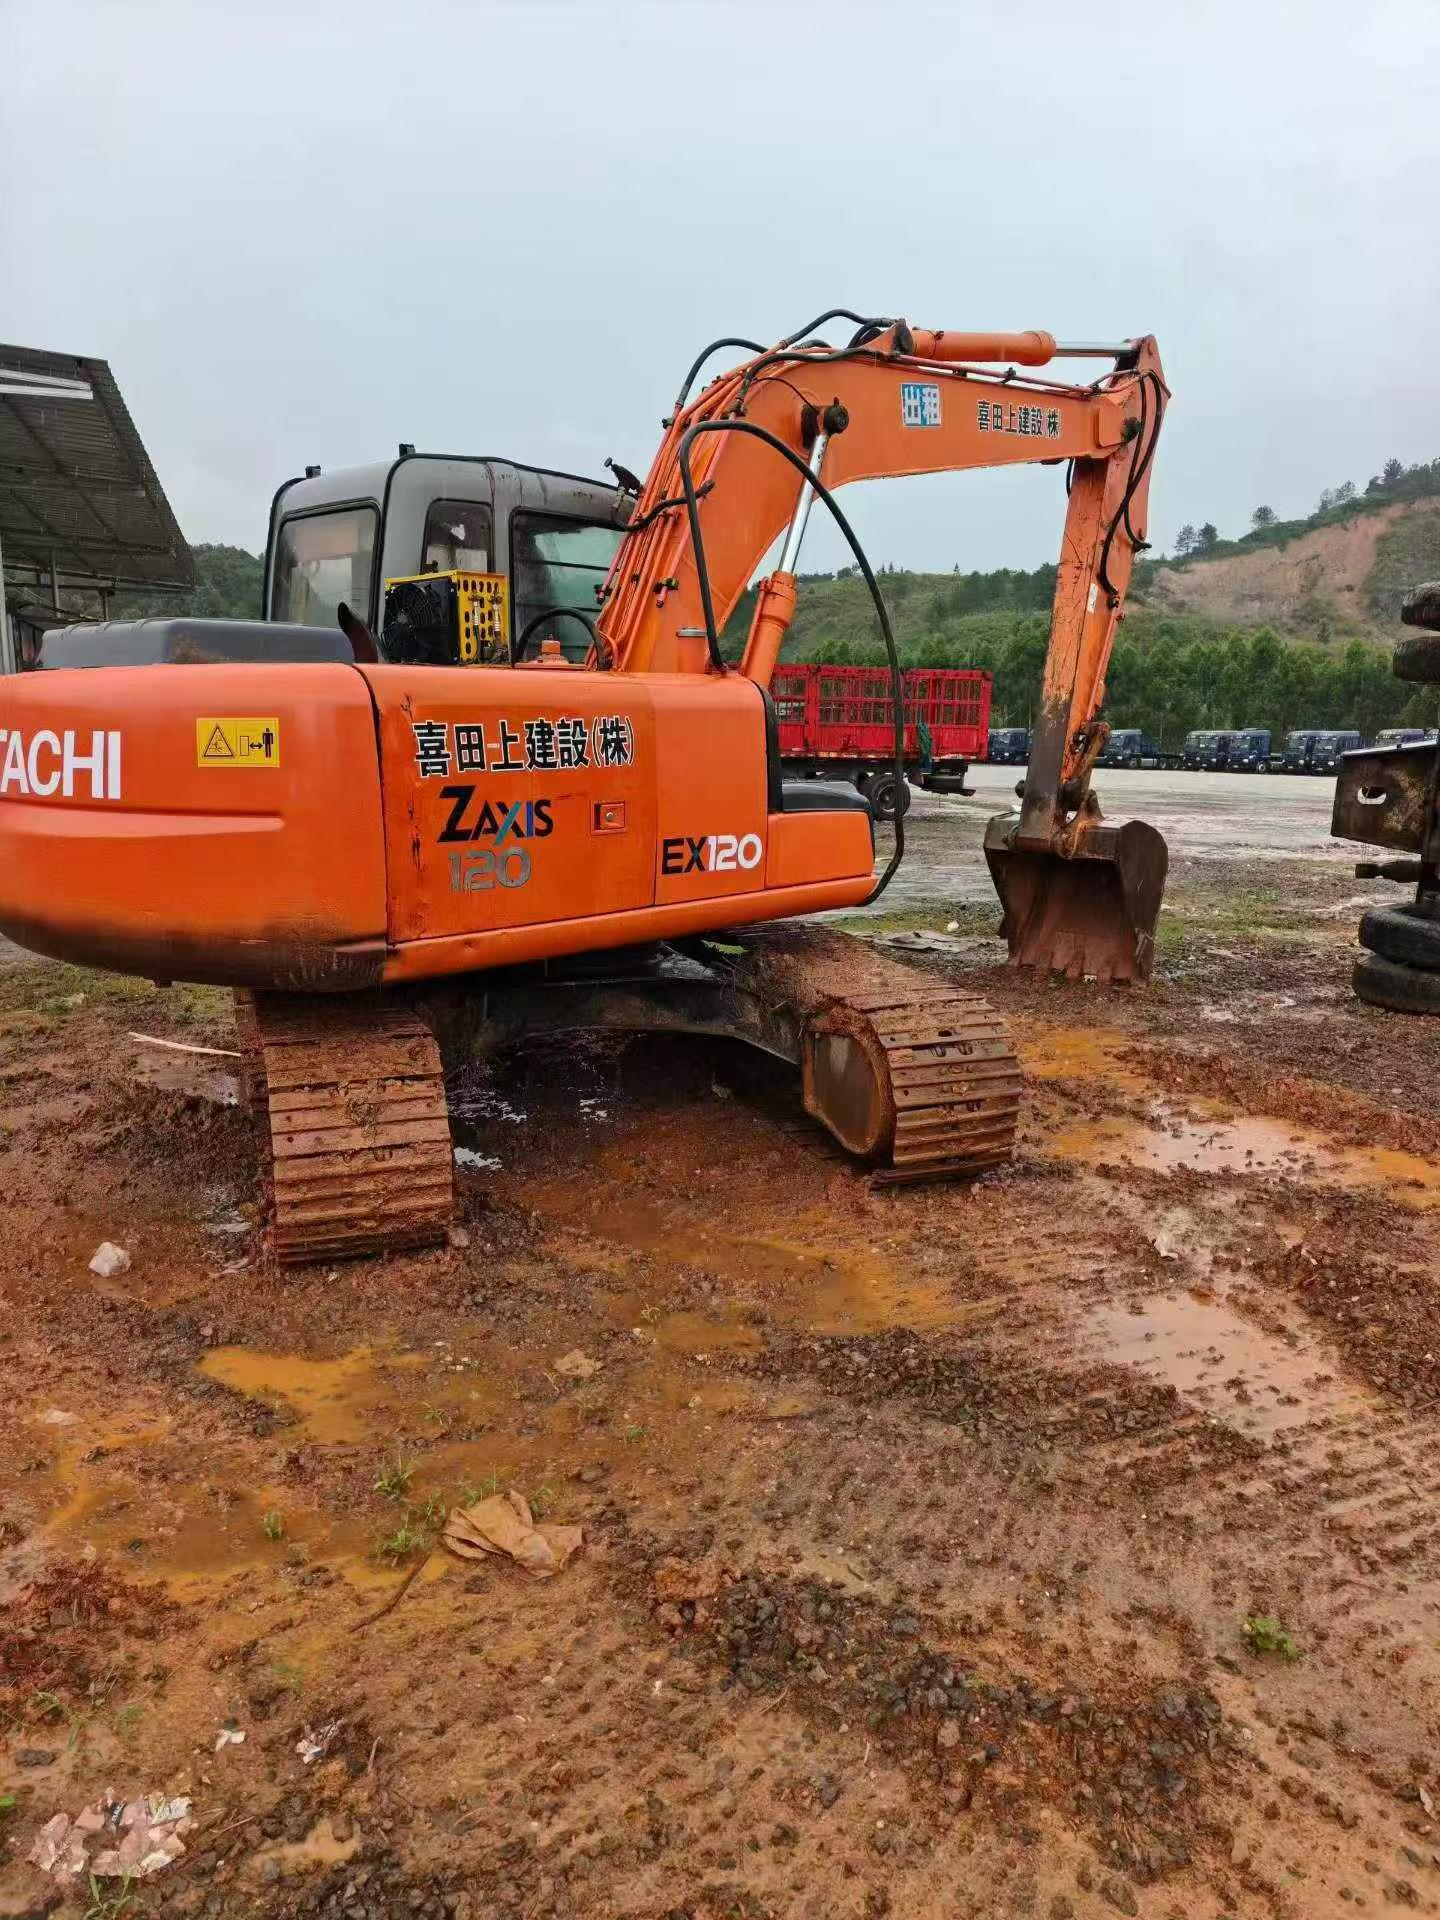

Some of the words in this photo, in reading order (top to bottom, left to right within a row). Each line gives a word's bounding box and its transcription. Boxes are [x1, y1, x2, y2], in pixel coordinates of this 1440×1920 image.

[436, 785, 554, 845] ZAXIS
[448, 846, 533, 895] 120
[661, 833, 763, 875] EX120
